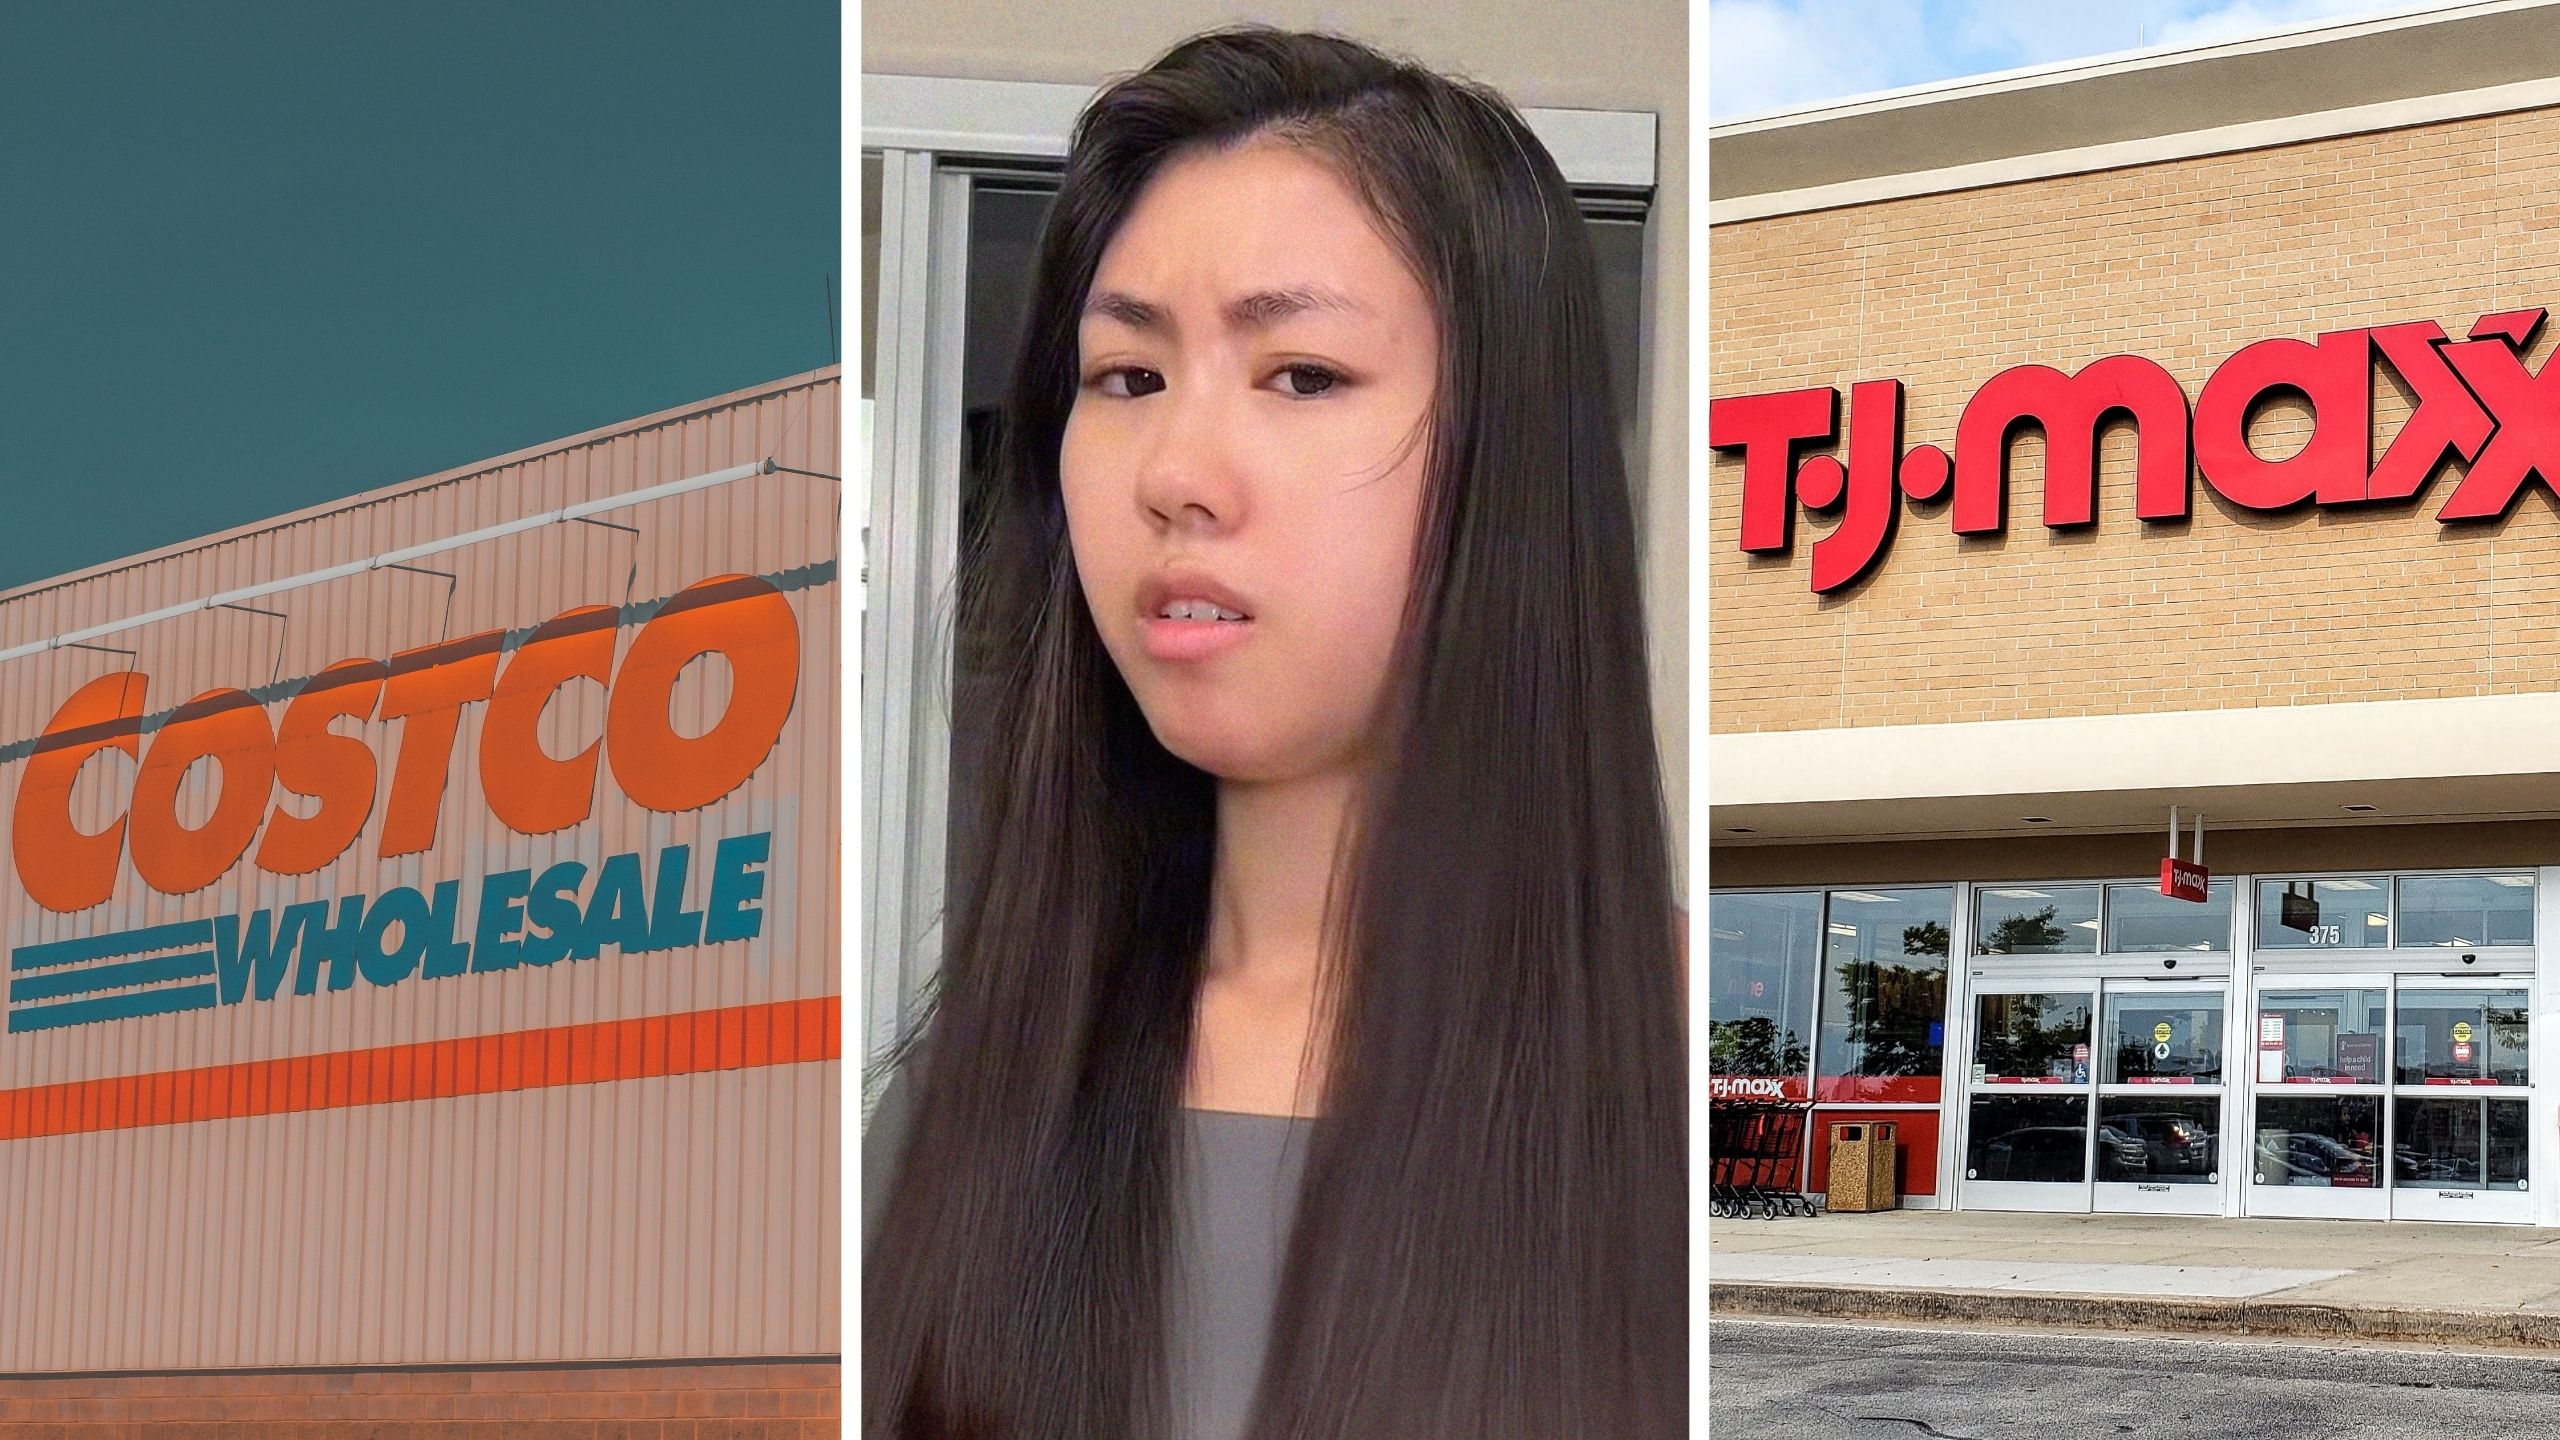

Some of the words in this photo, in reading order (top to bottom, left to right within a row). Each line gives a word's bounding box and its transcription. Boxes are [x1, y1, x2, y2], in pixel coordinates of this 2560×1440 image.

[13, 573, 801, 914] COSTCO
[212, 832, 771, 1005] WHOLESALE
[2309, 926, 2340, 944] 375
